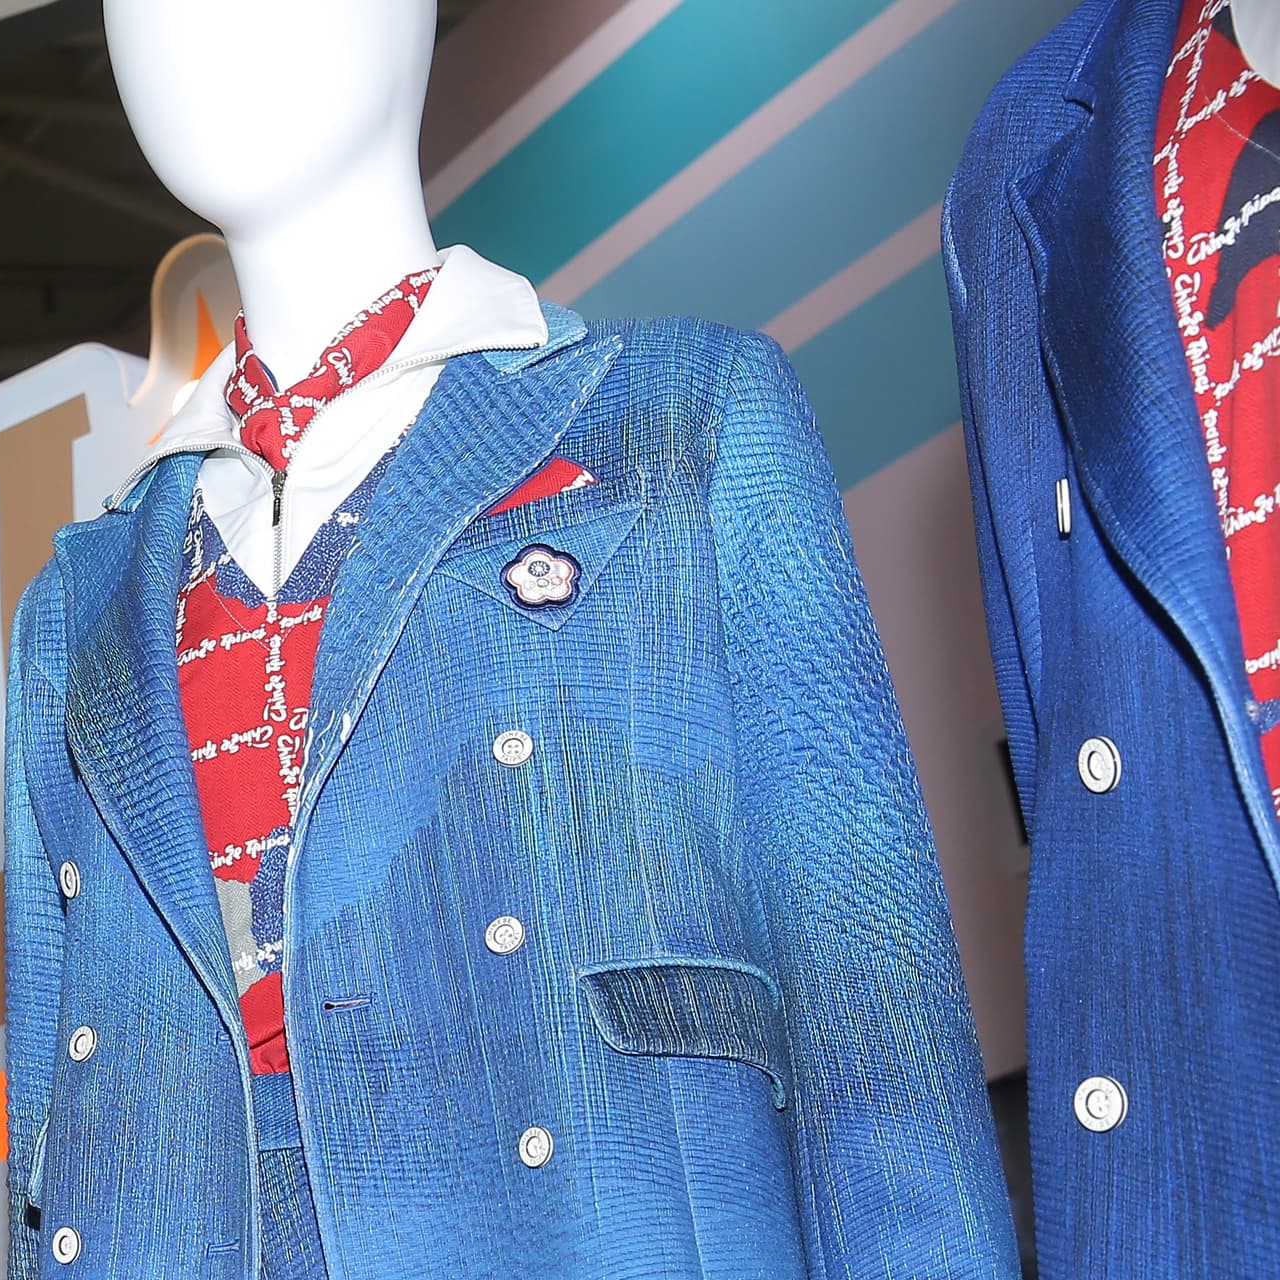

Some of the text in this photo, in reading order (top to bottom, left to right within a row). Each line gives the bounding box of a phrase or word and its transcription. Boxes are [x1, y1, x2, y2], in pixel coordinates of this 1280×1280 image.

[1238, 187, 1280, 227] Taip
[1174, 272, 1216, 395] Chinese Taipei
[220, 624, 267, 650] Taipei
[263, 634, 288, 722] Chinese Taipei
[221, 725, 274, 754] Chinese
[277, 734, 301, 785] Chinese
